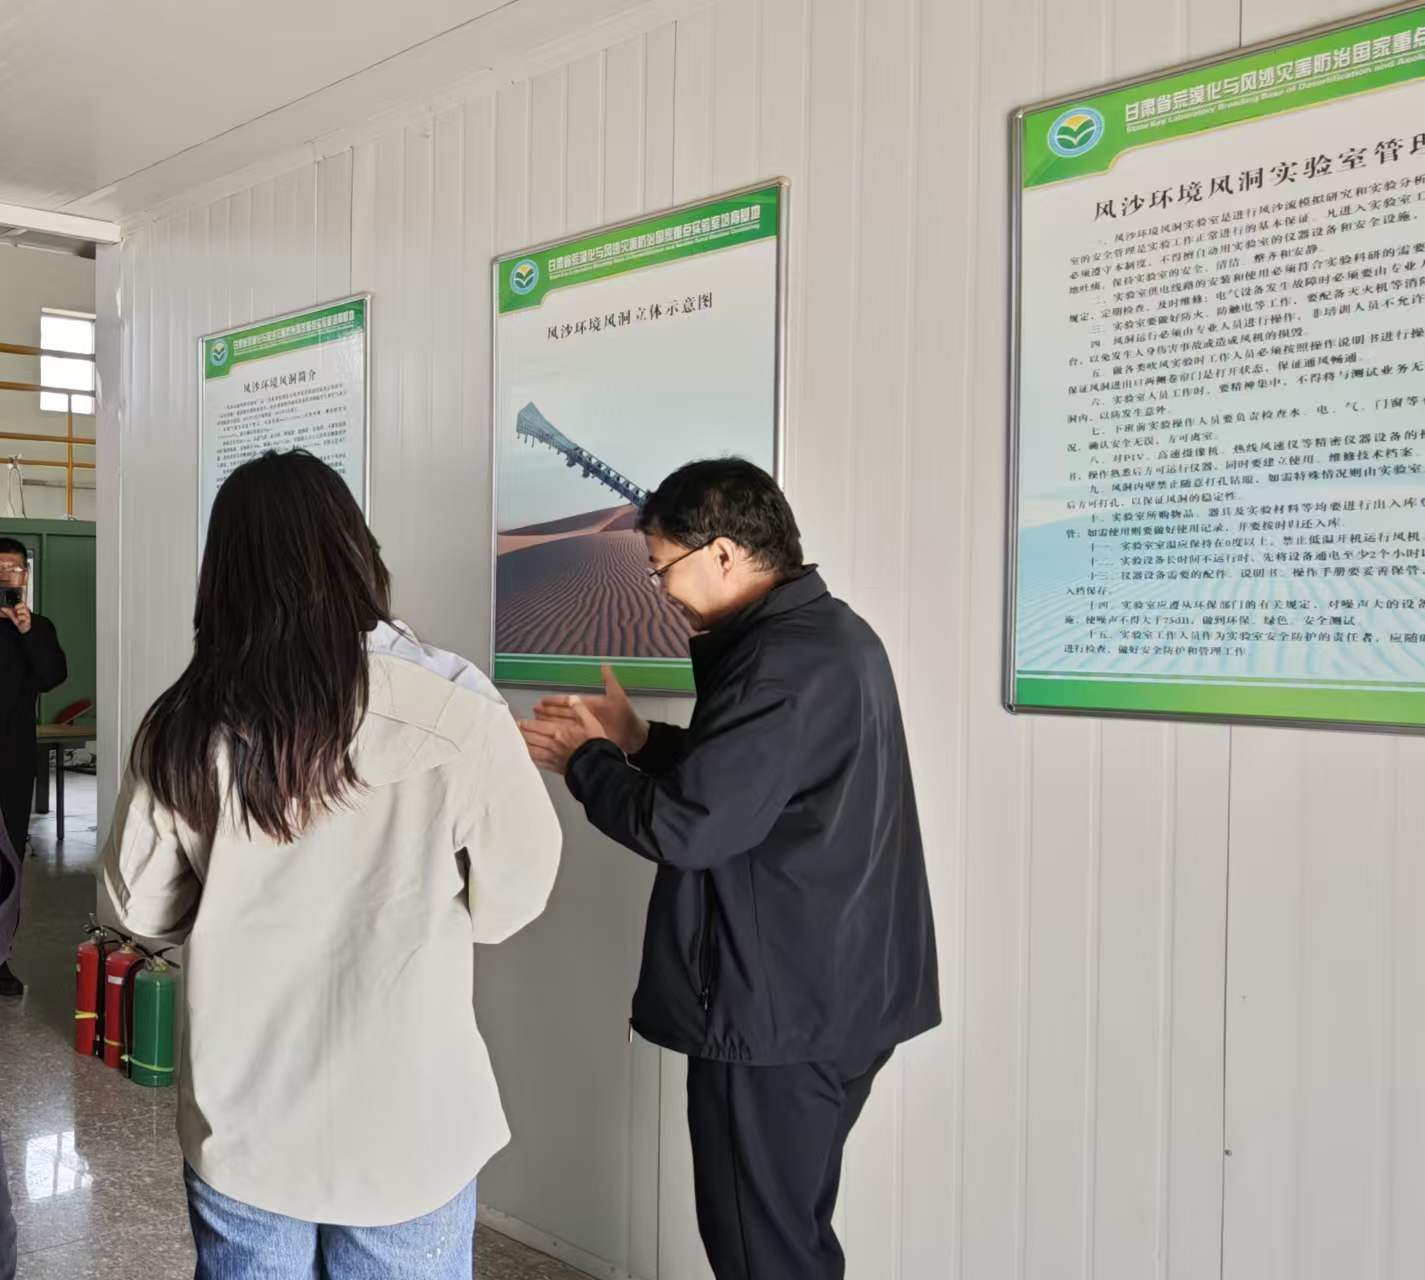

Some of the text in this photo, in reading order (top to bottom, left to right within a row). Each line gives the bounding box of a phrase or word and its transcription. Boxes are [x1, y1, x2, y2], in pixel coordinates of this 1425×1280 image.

[547, 292, 713, 342] 风沙环境风洞立体示意图
[243, 369, 316, 393] 风沙环境风洞简介
